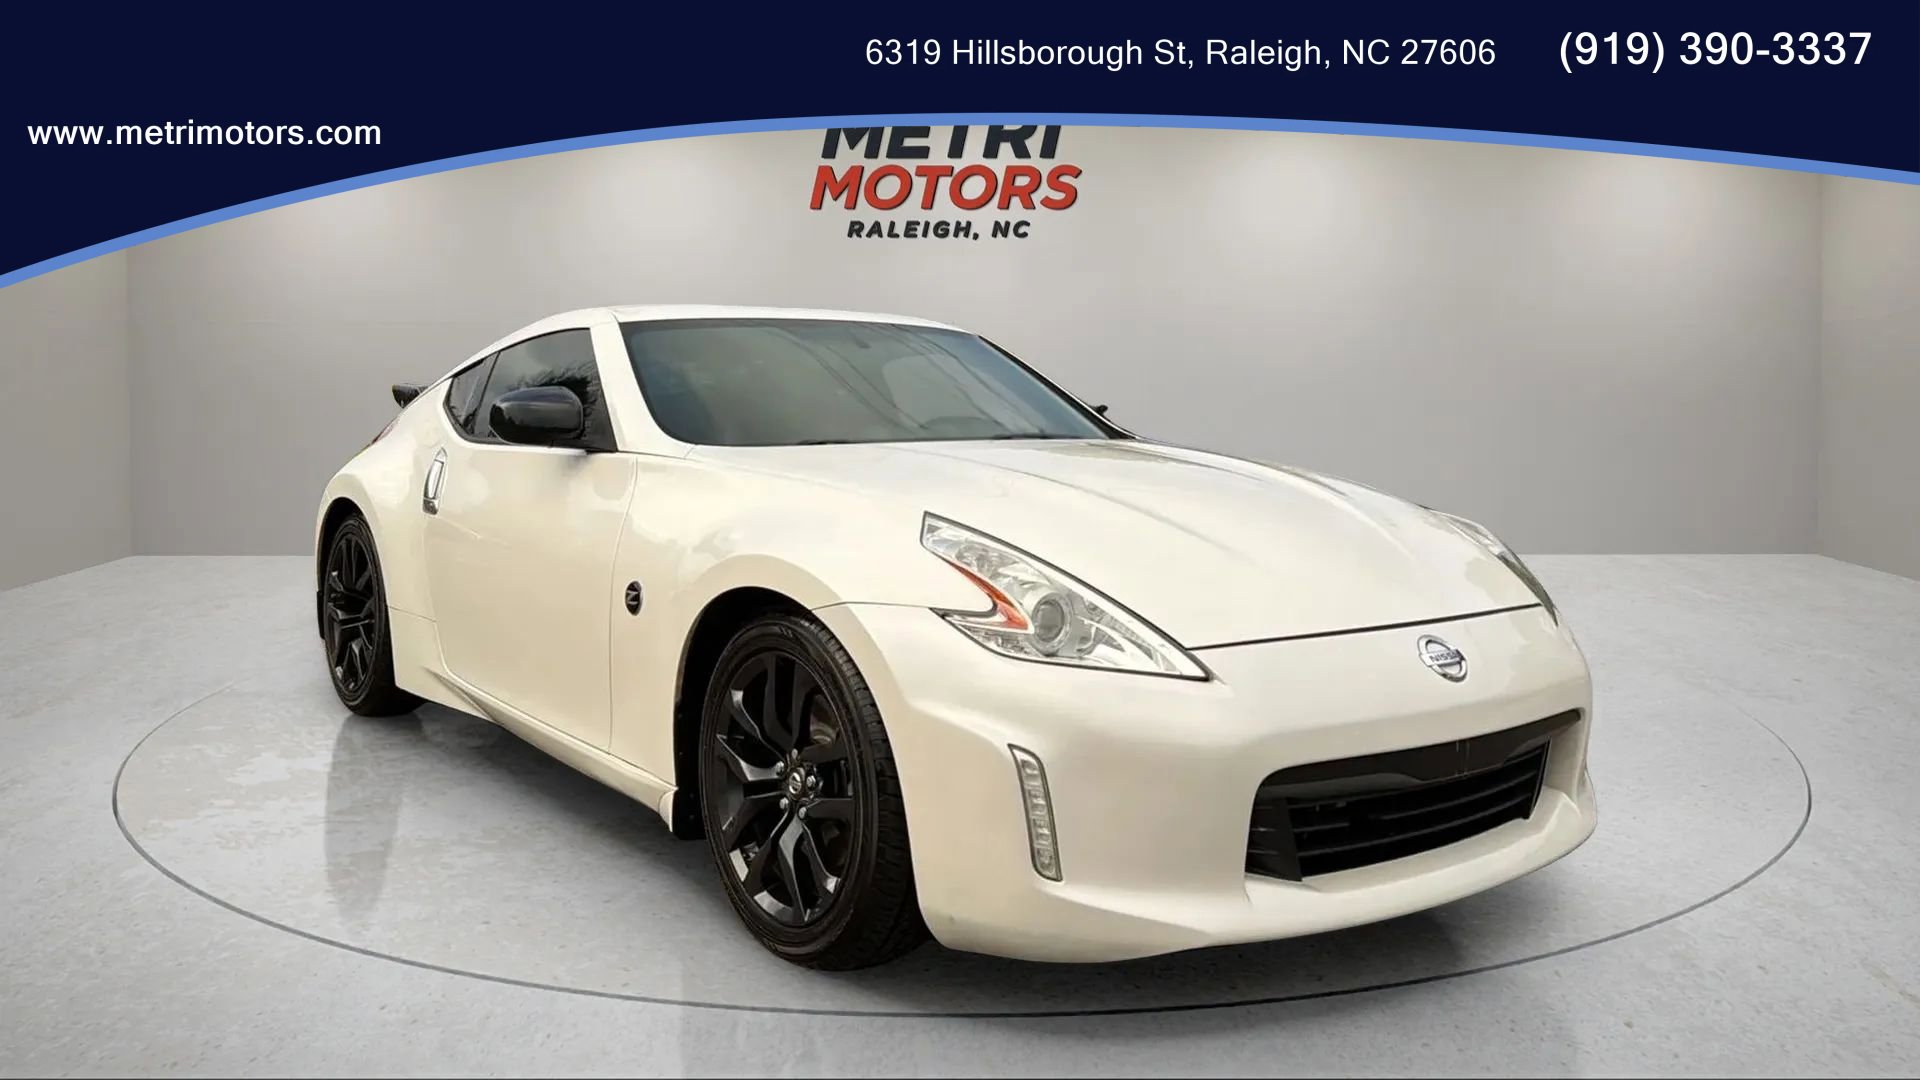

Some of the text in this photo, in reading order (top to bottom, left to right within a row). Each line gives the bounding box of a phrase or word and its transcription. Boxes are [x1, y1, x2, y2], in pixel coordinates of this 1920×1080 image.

[810, 165, 1082, 210] MOTORS
[847, 220, 1031, 240] RALEIGH, NC
[1429, 648, 1461, 662] NISS
